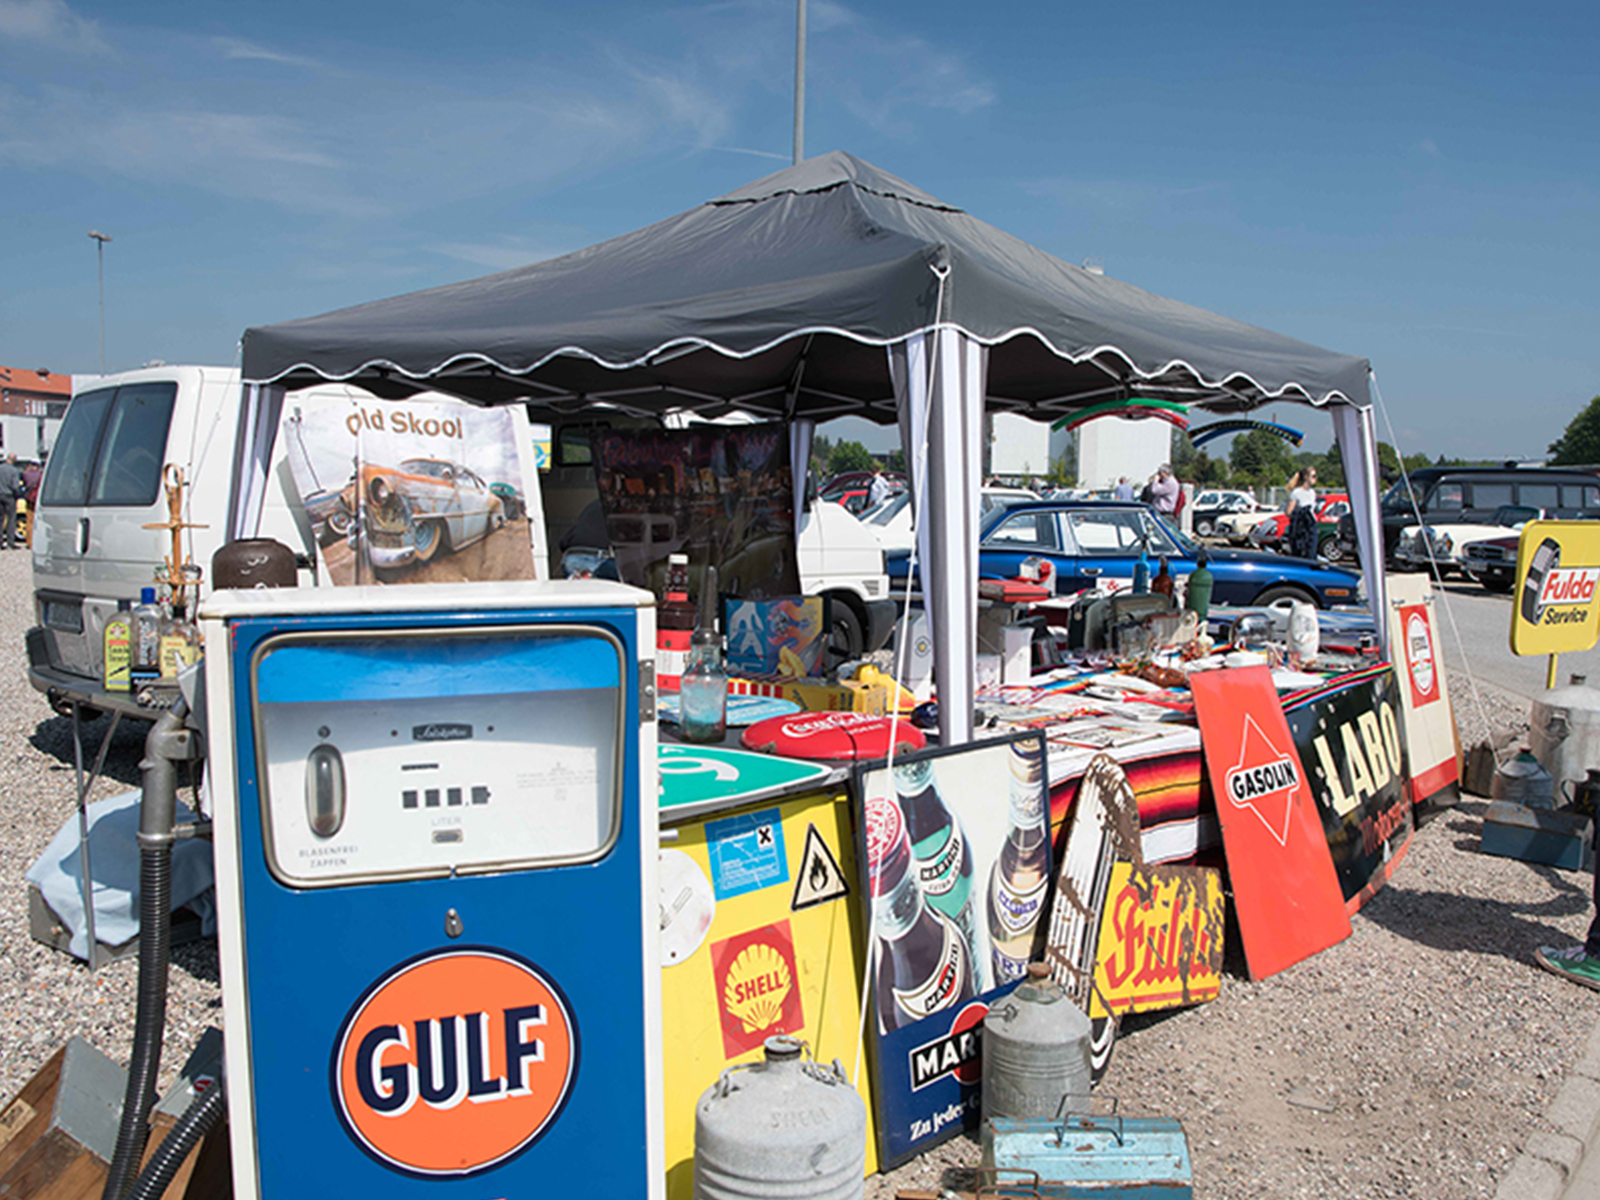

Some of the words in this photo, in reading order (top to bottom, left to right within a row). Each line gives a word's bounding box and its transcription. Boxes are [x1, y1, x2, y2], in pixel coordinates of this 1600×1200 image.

[346, 407, 385, 436] Old
[390, 411, 462, 439] Skool
[1542, 571, 1595, 601] Fulda
[1544, 607, 1588, 625] Service
[1313, 701, 1402, 818] LABO
[1232, 761, 1297, 800] GASOLIN
[734, 970, 785, 1005] SHELL
[355, 1003, 547, 1118] GULF
